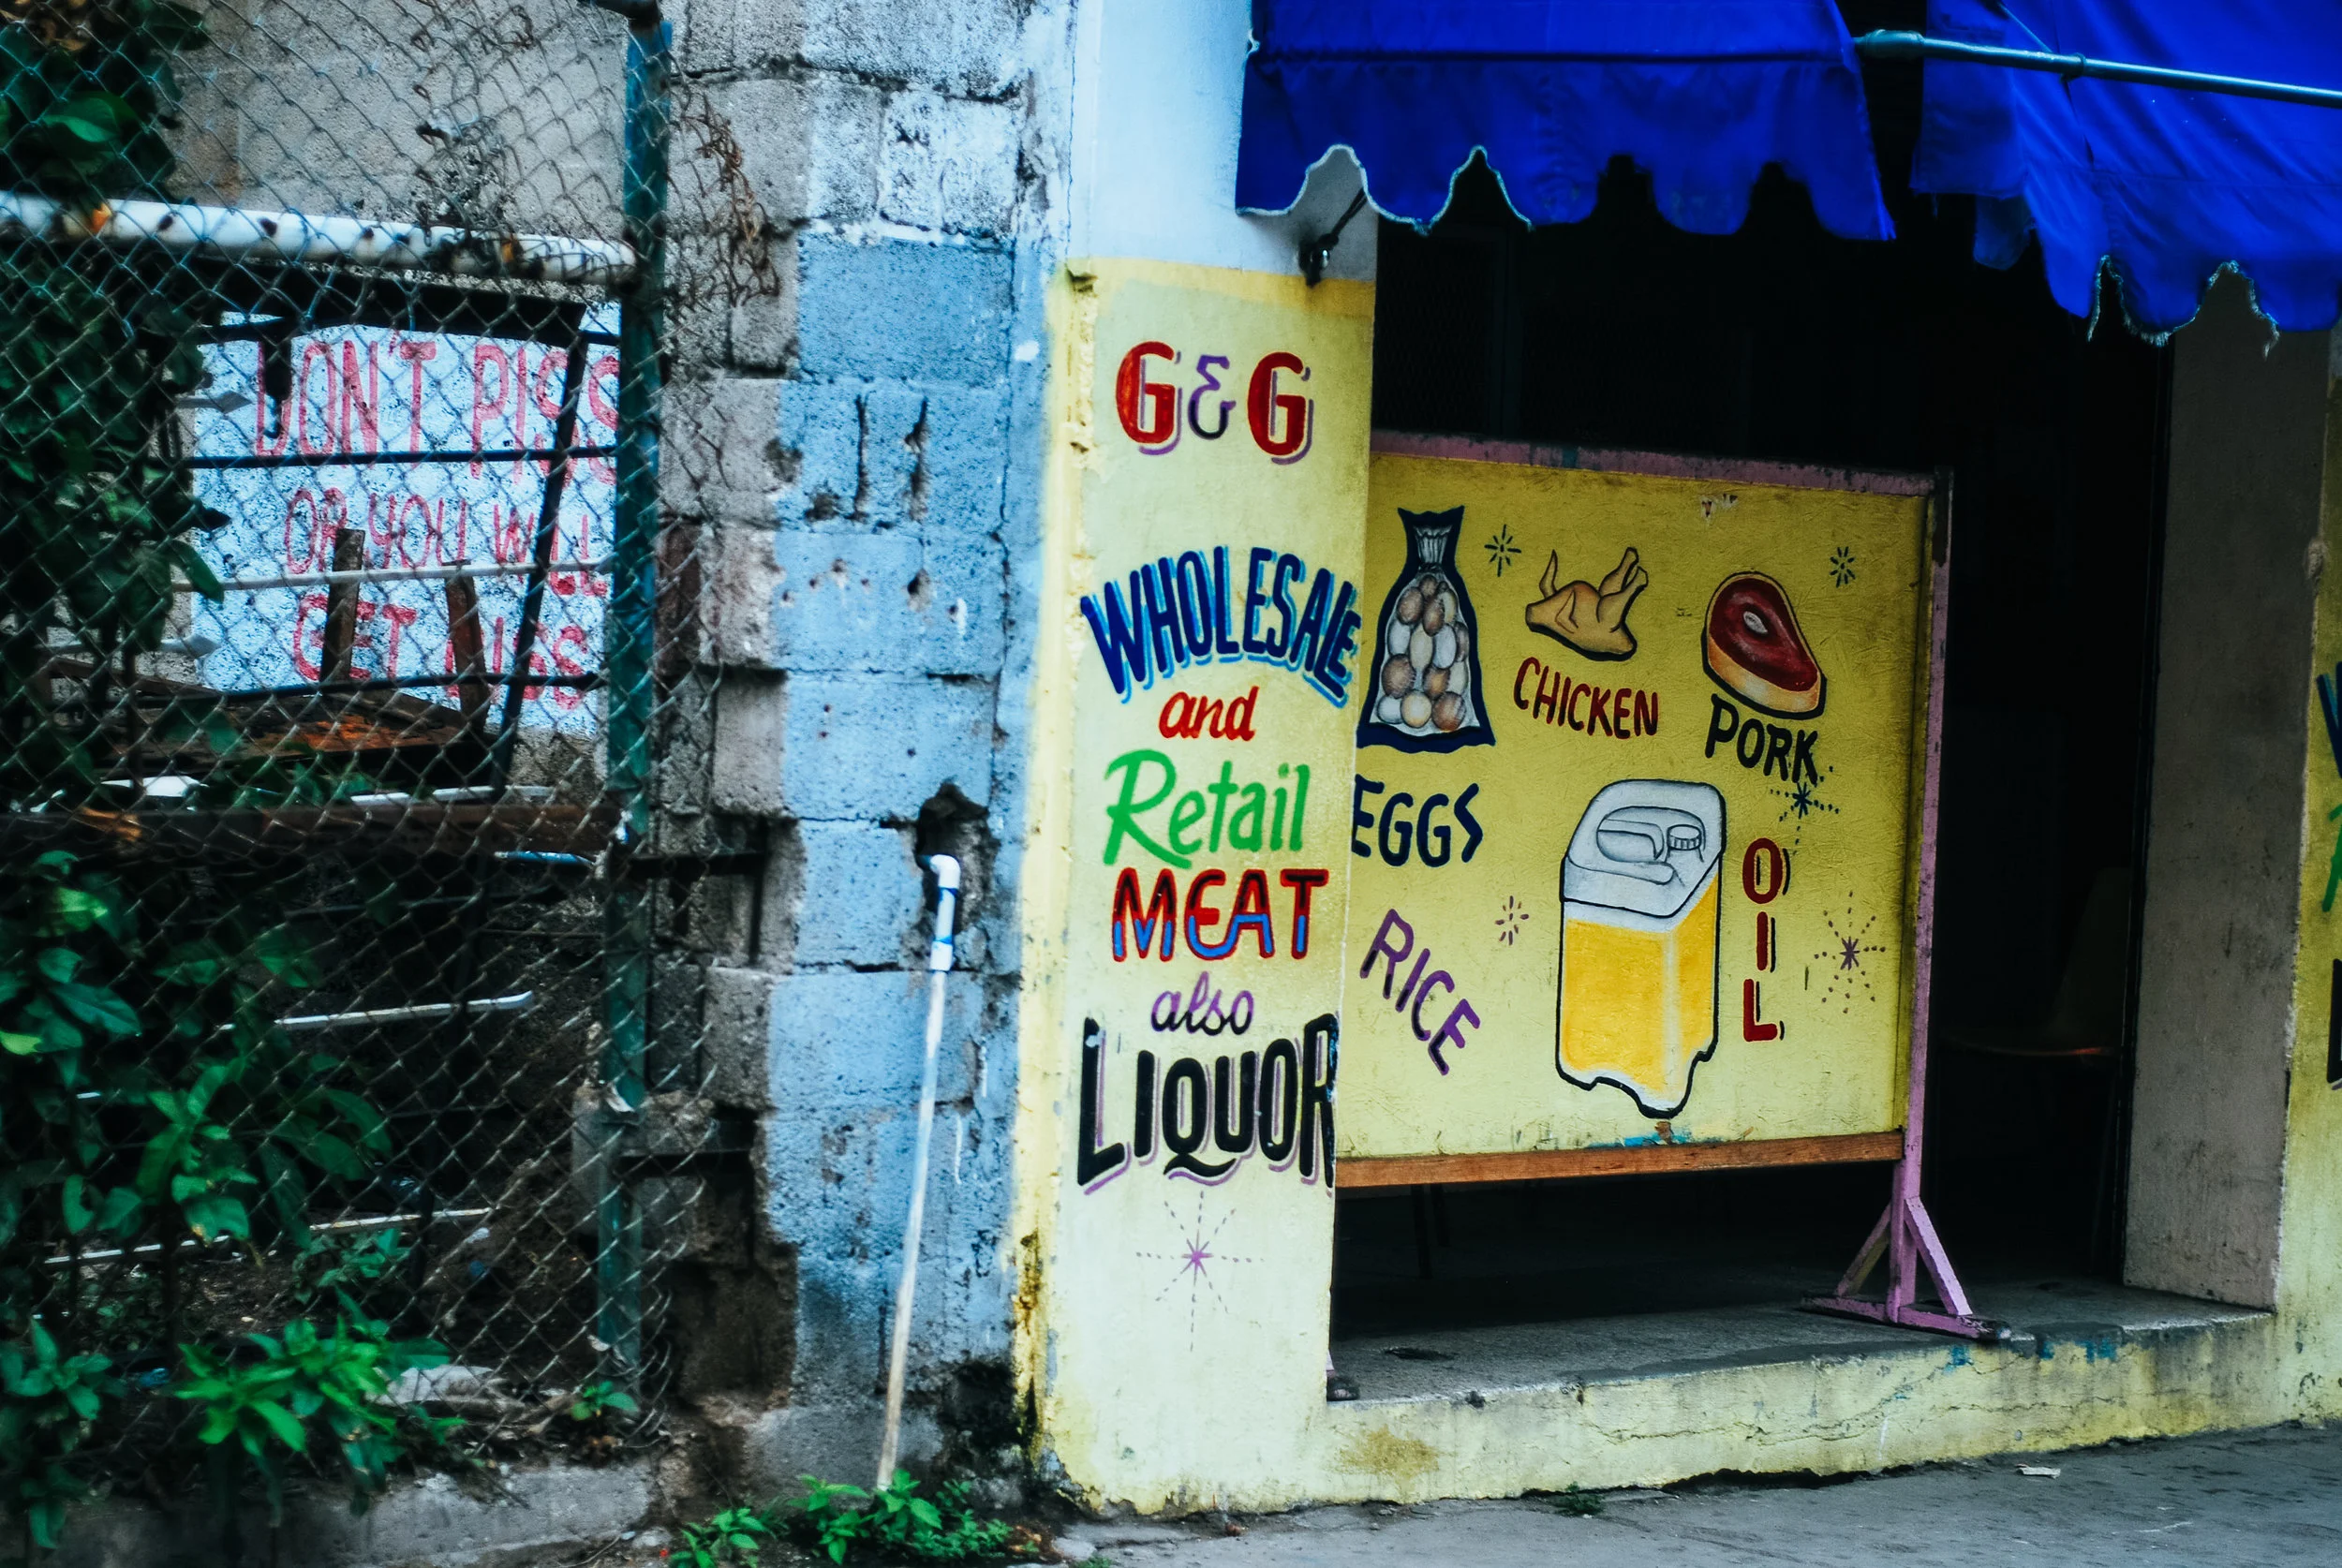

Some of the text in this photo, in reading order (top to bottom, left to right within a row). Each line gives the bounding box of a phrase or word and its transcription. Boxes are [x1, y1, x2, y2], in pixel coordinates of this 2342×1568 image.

[1115, 341, 1314, 466] G & G
[493, 503, 608, 596] WLL
[1080, 545, 1362, 709] WHOLESALE
[1159, 686, 1259, 742] and
[1514, 657, 1659, 739] CHICKEN
[1704, 693, 1818, 783] PORK
[1103, 748, 1312, 869] Retail
[1351, 774, 1484, 867] EGGS
[1111, 866, 1330, 963] MEAT
[1742, 837, 1791, 1043] OIL
[1150, 970, 1254, 1036] also
[1359, 909, 1481, 1076] RICE
[1076, 1011, 1340, 1197] LIQUOR
